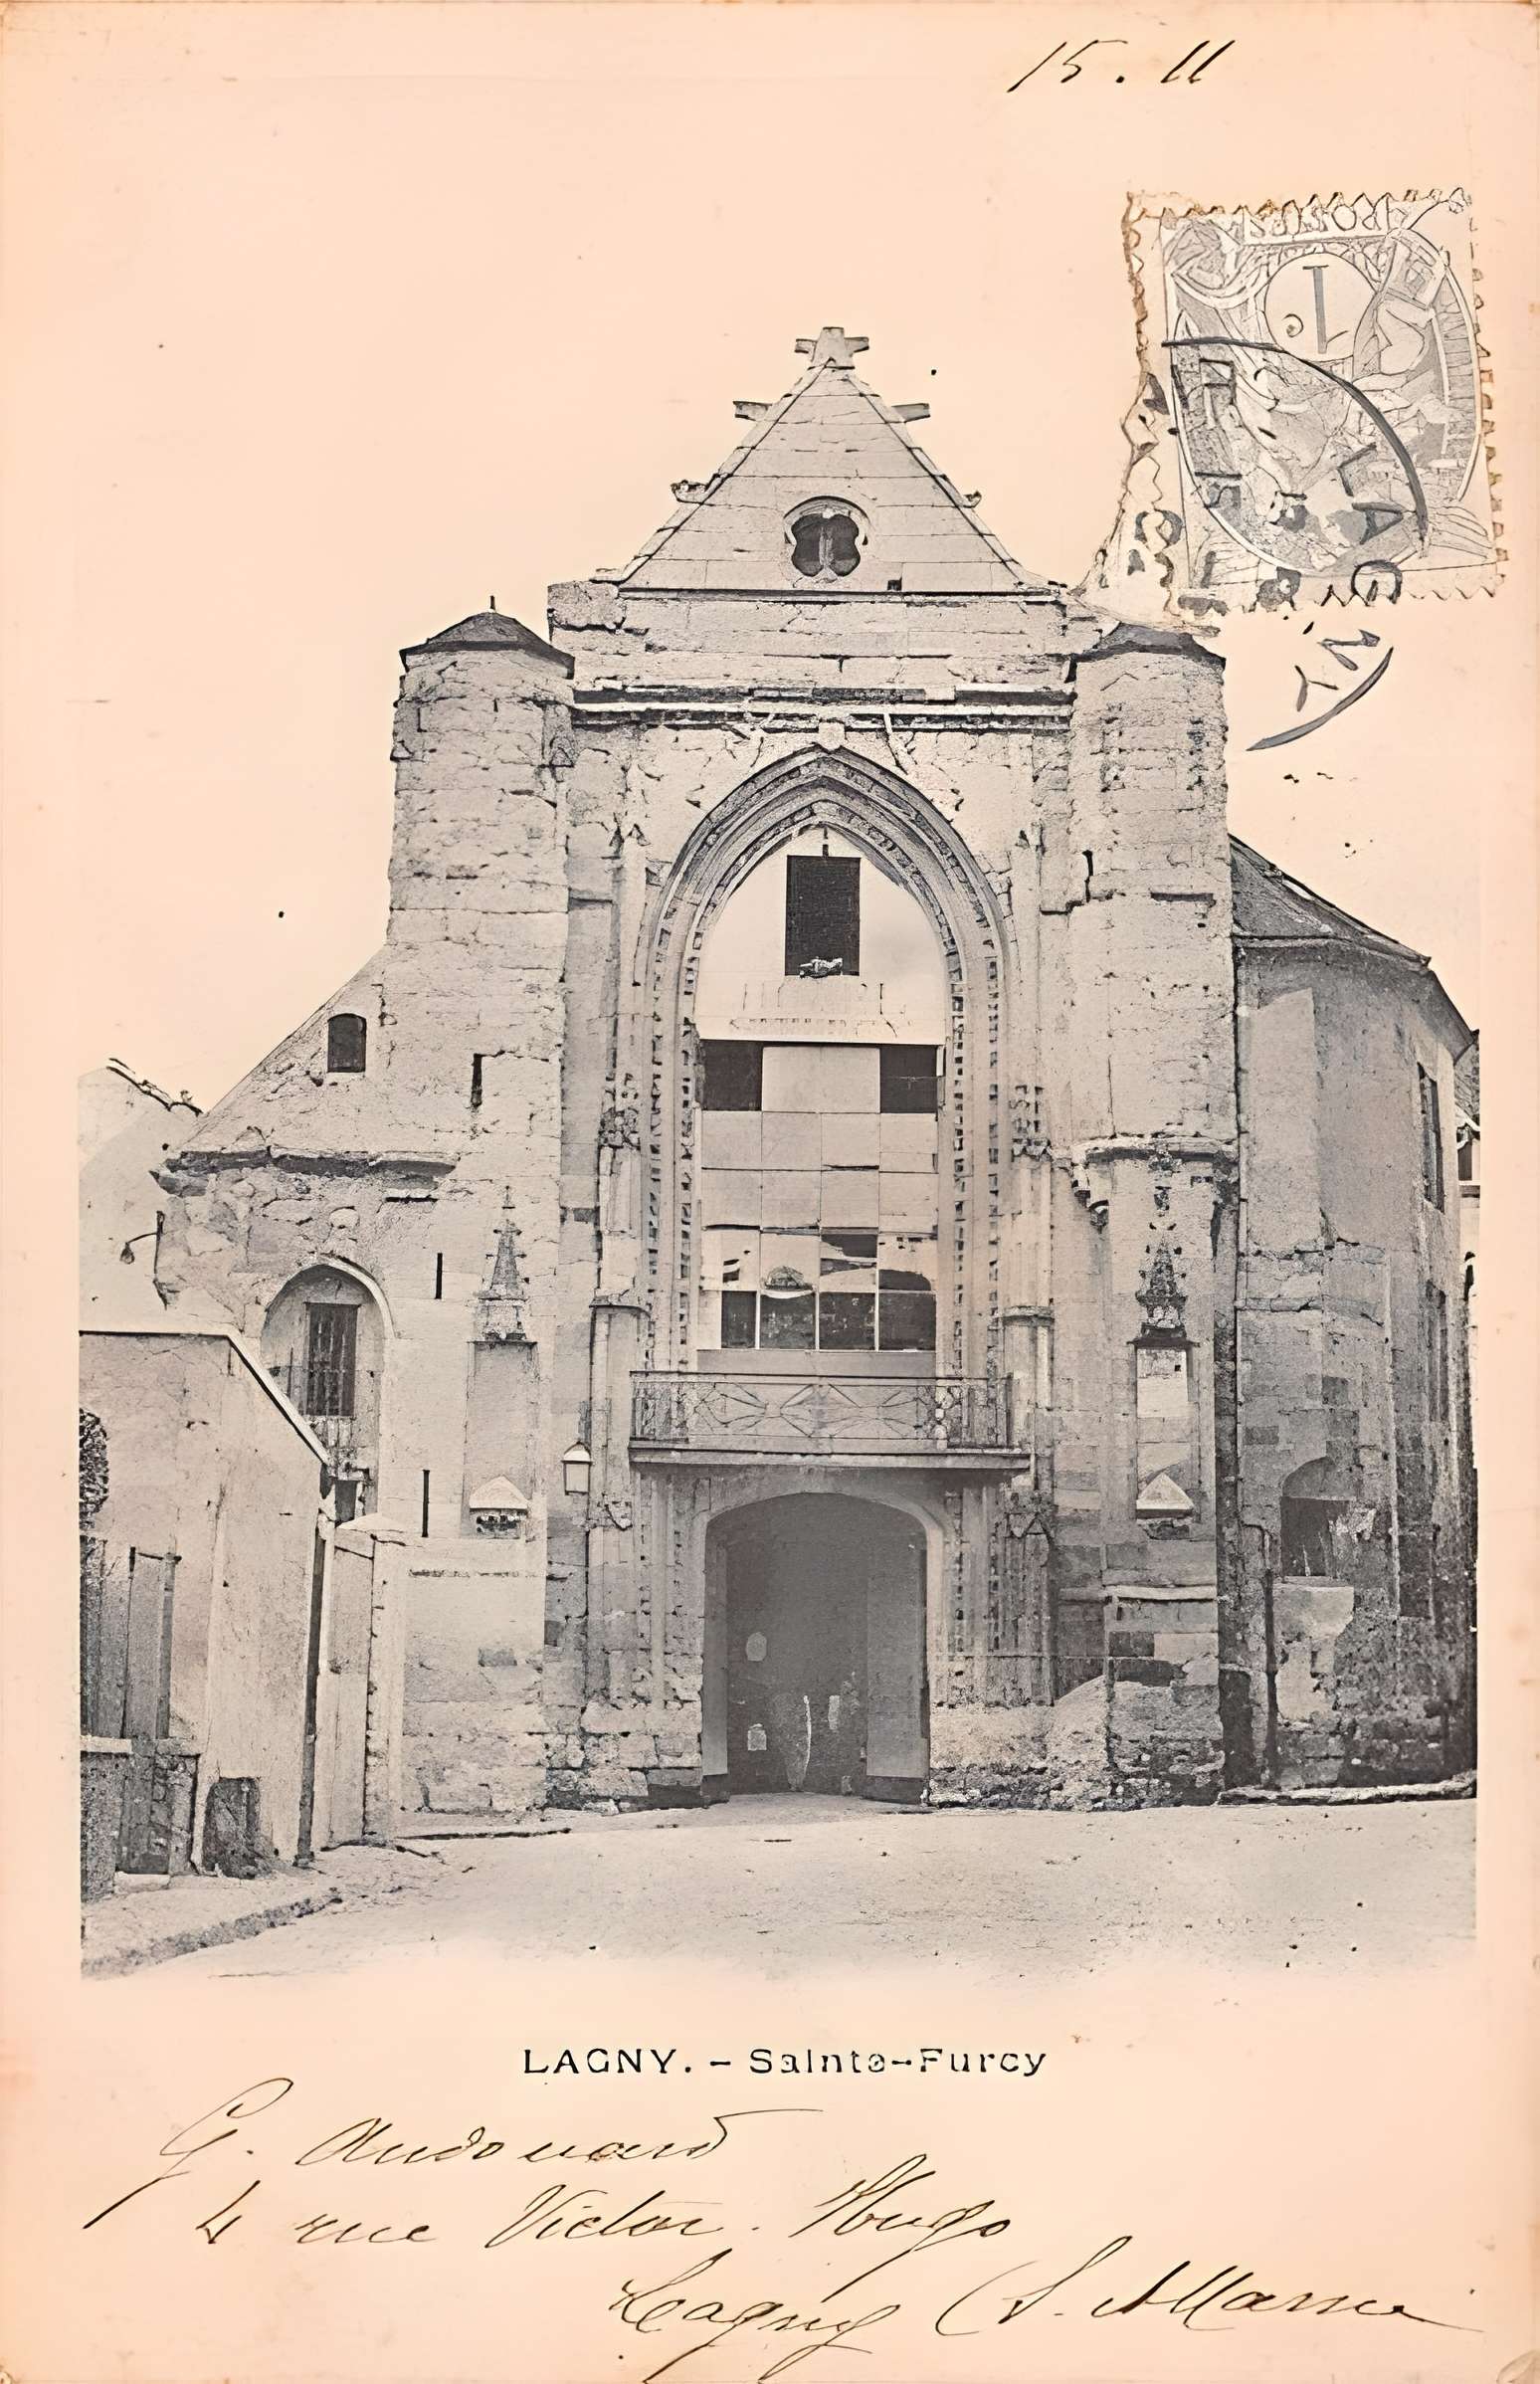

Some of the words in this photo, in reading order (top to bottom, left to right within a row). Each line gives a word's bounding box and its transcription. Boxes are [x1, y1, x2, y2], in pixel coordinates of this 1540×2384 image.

[292, 2213, 439, 2245] rue
[787, 2152, 1013, 2304] Hugo
[607, 2247, 902, 2384] Lagny
